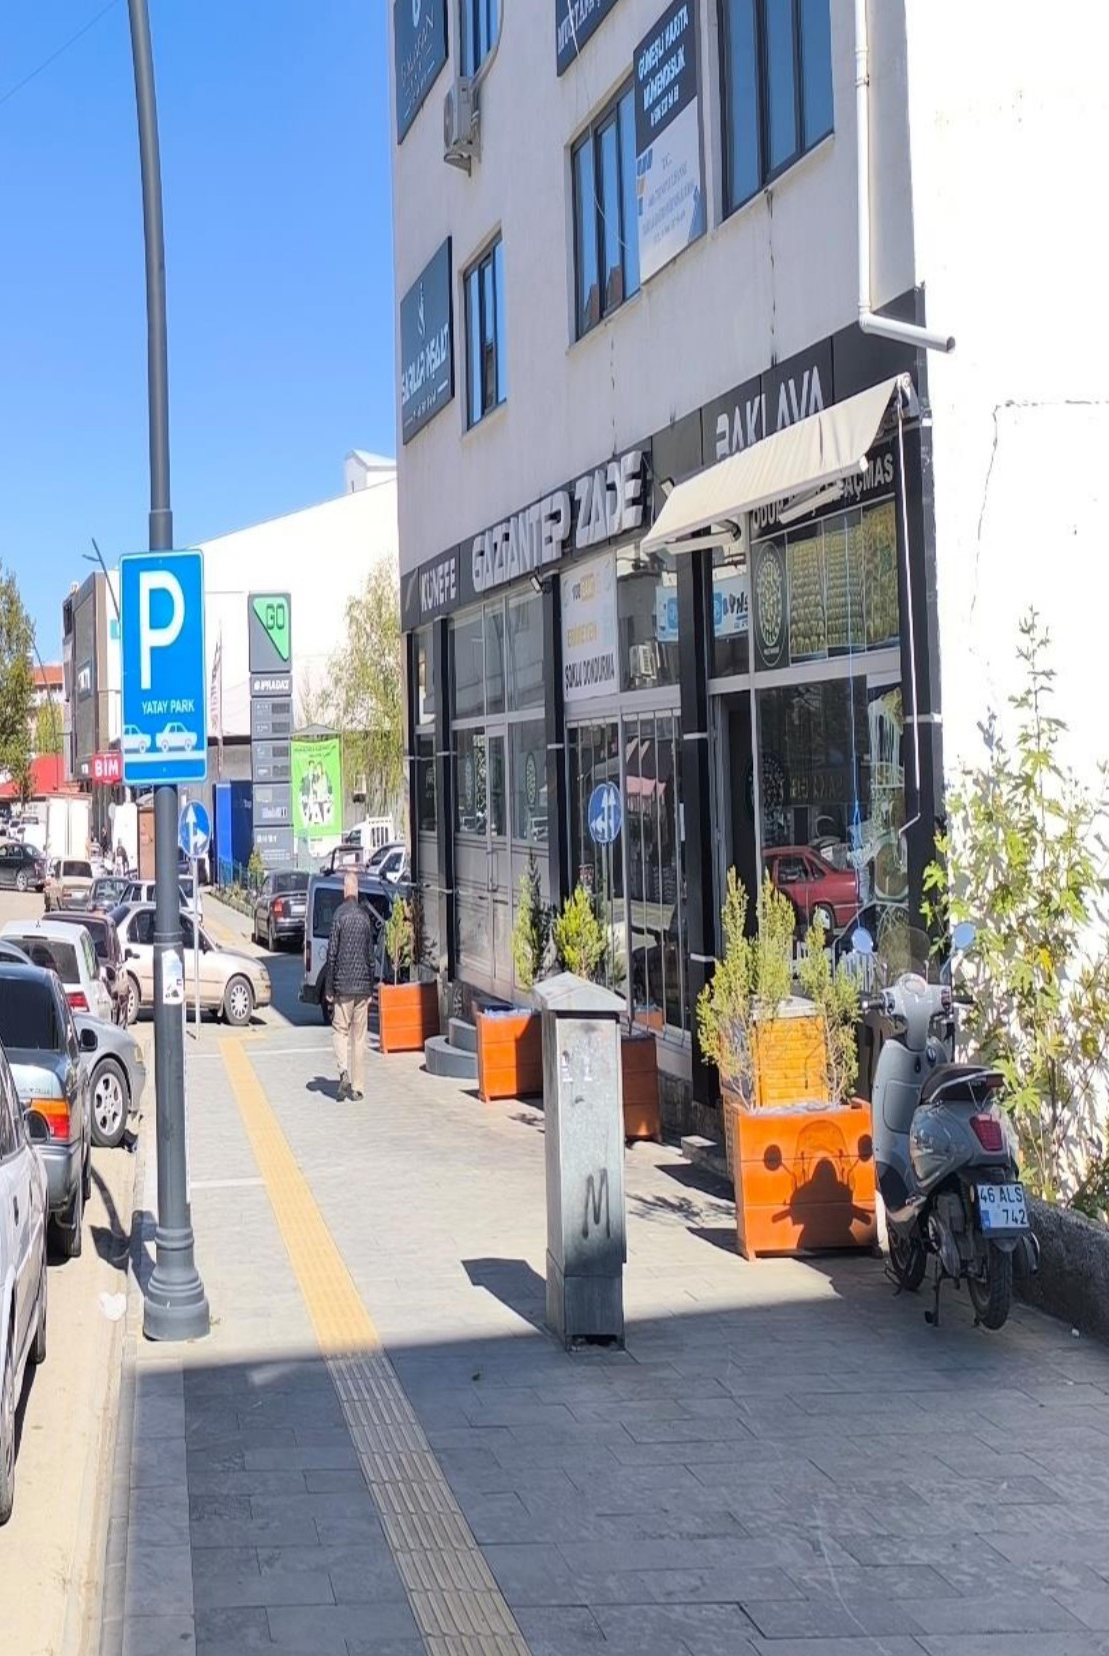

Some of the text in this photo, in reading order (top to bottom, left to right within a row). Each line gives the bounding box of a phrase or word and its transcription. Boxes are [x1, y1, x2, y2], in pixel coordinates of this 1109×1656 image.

[575, 450, 643, 549] ZADE
[265, 603, 285, 630] GO
[139, 571, 186, 690] P
[141, 699, 195, 714] YATAY PARK
[980, 1186, 1023, 1204] 46 ALS
[1002, 1208, 1027, 1224] 742
